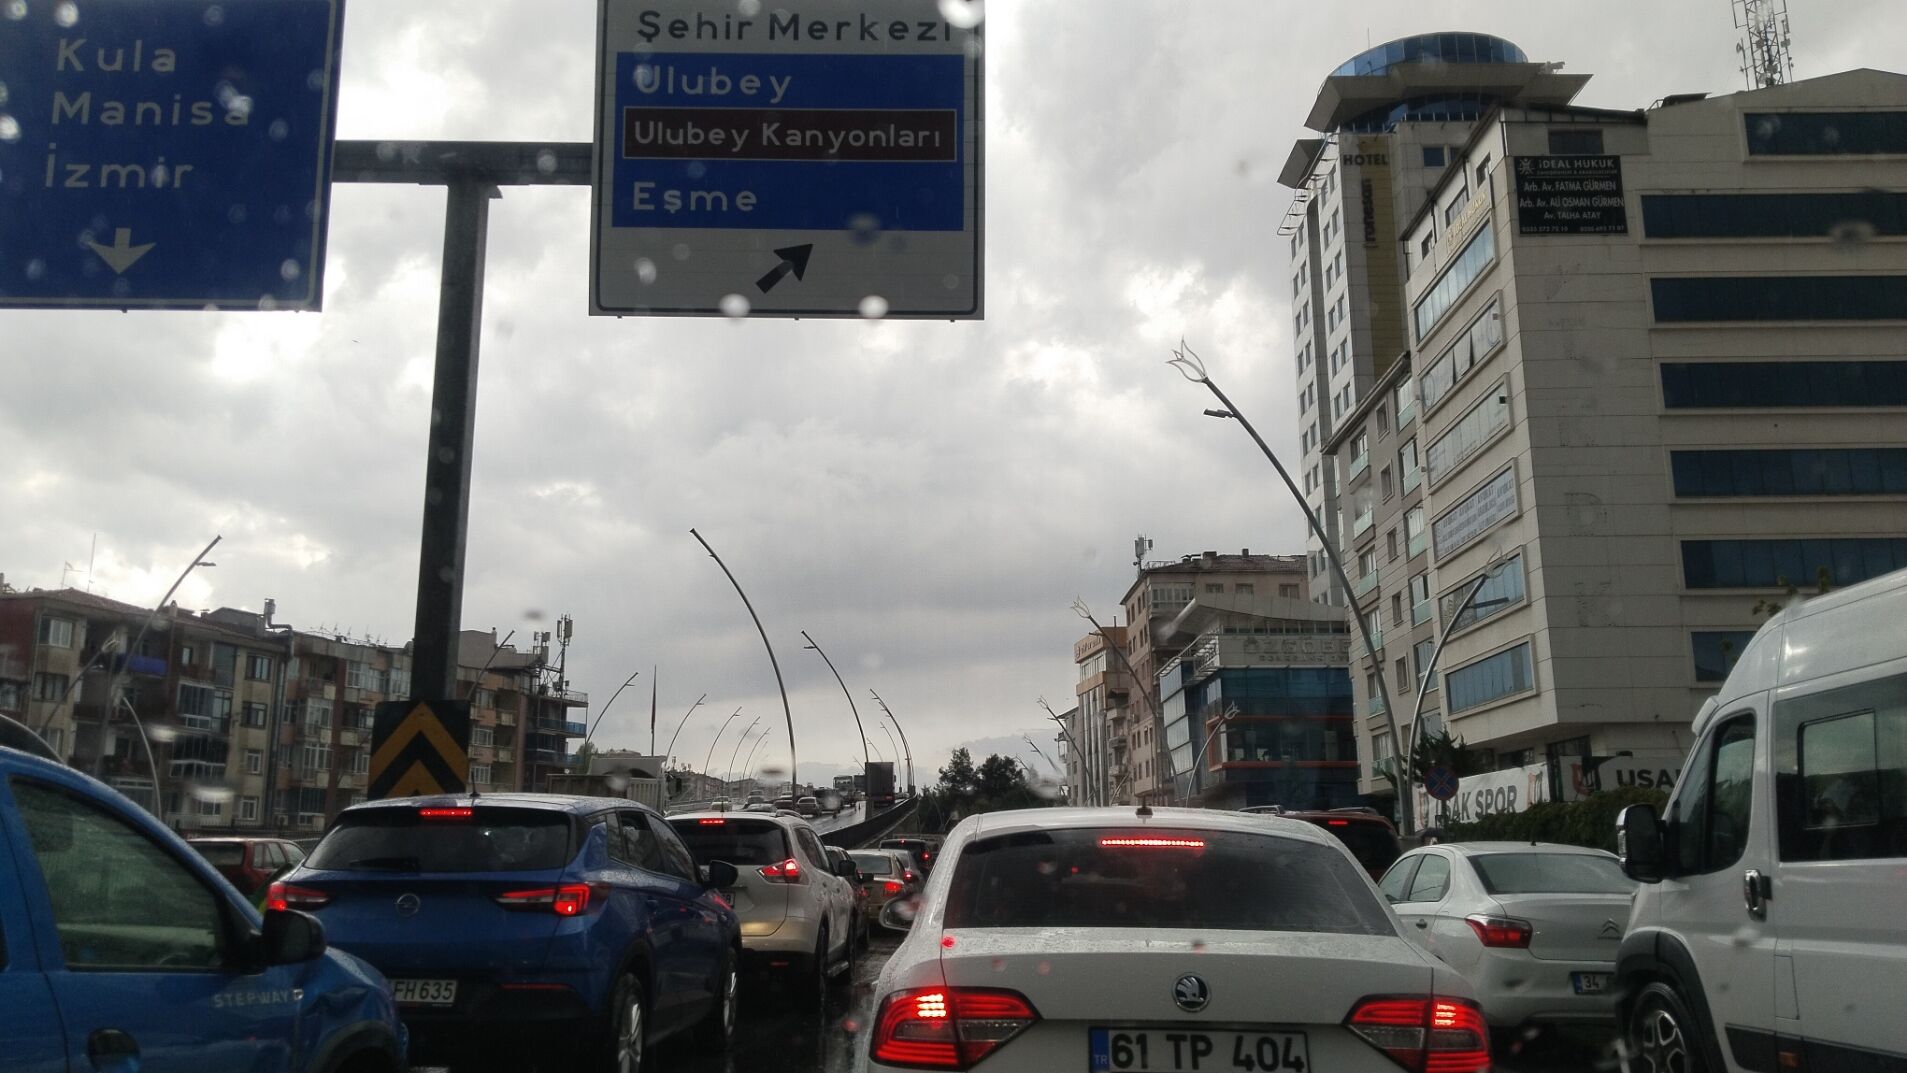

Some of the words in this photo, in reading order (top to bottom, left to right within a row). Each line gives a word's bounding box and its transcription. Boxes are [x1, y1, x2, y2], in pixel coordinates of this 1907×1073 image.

[636, 10, 752, 43] Şehir
[768, 12, 951, 42] Merkezi
[57, 38, 176, 72] Kula
[636, 66, 792, 103] Ulubey
[52, 91, 250, 126] Manisa
[634, 121, 750, 152] Ulubey
[762, 122, 941, 154] Kanyonları
[45, 143, 194, 188] İzmir
[1343, 154, 1389, 166] HOTEL
[1574, 159, 1615, 168] HUKUK
[632, 182, 758, 213] Eşme
[1555, 181, 1581, 191] FATMA
[1583, 179, 1616, 191] GÜRMEN
[1562, 198, 1591, 207] OSMAN
[1591, 196, 1625, 207] GÜRMEN
[1557, 211, 1581, 219] TALHA
[1582, 211, 1601, 219] ATAY
[1475, 785, 1518, 820] SPOR
[420, 981, 454, 1000] 635
[1583, 975, 1600, 989] 34
[213, 990, 288, 1008] STEPWAY
[1094, 1054, 1108, 1065] TR
[1111, 1033, 1149, 1070] 61
[1166, 1034, 1213, 1071] TP
[1232, 1035, 1305, 1073] 404
